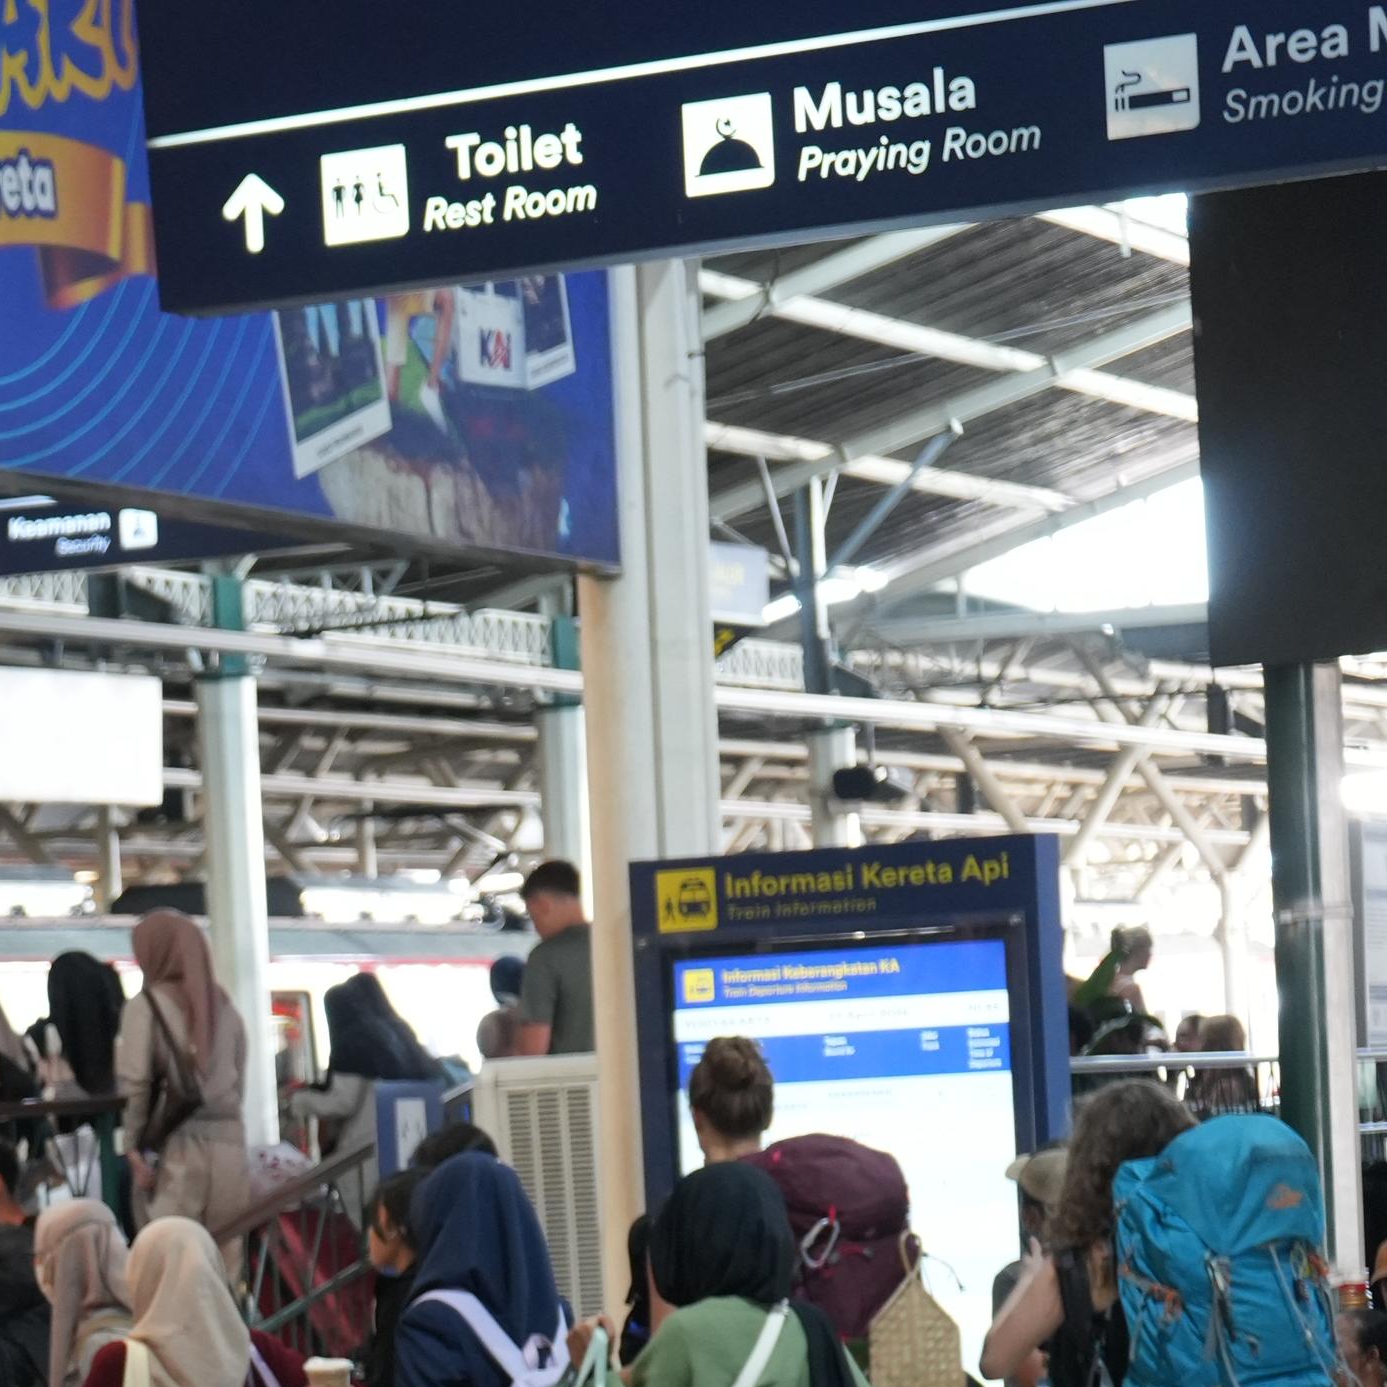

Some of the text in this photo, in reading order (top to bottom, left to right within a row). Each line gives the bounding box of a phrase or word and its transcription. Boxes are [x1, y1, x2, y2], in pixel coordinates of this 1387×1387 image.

[1221, 23, 1350, 74] Area
[793, 66, 978, 134] Musala
[1222, 73, 1386, 125] Smoking
[444, 122, 585, 182] Toilet
[796, 123, 1042, 183] Praying Room
[423, 182, 599, 234] Rest Room
[724, 852, 1010, 900] Informasi Kereta Api
[728, 896, 878, 921] Train Information
[721, 965, 781, 984] Informasi
